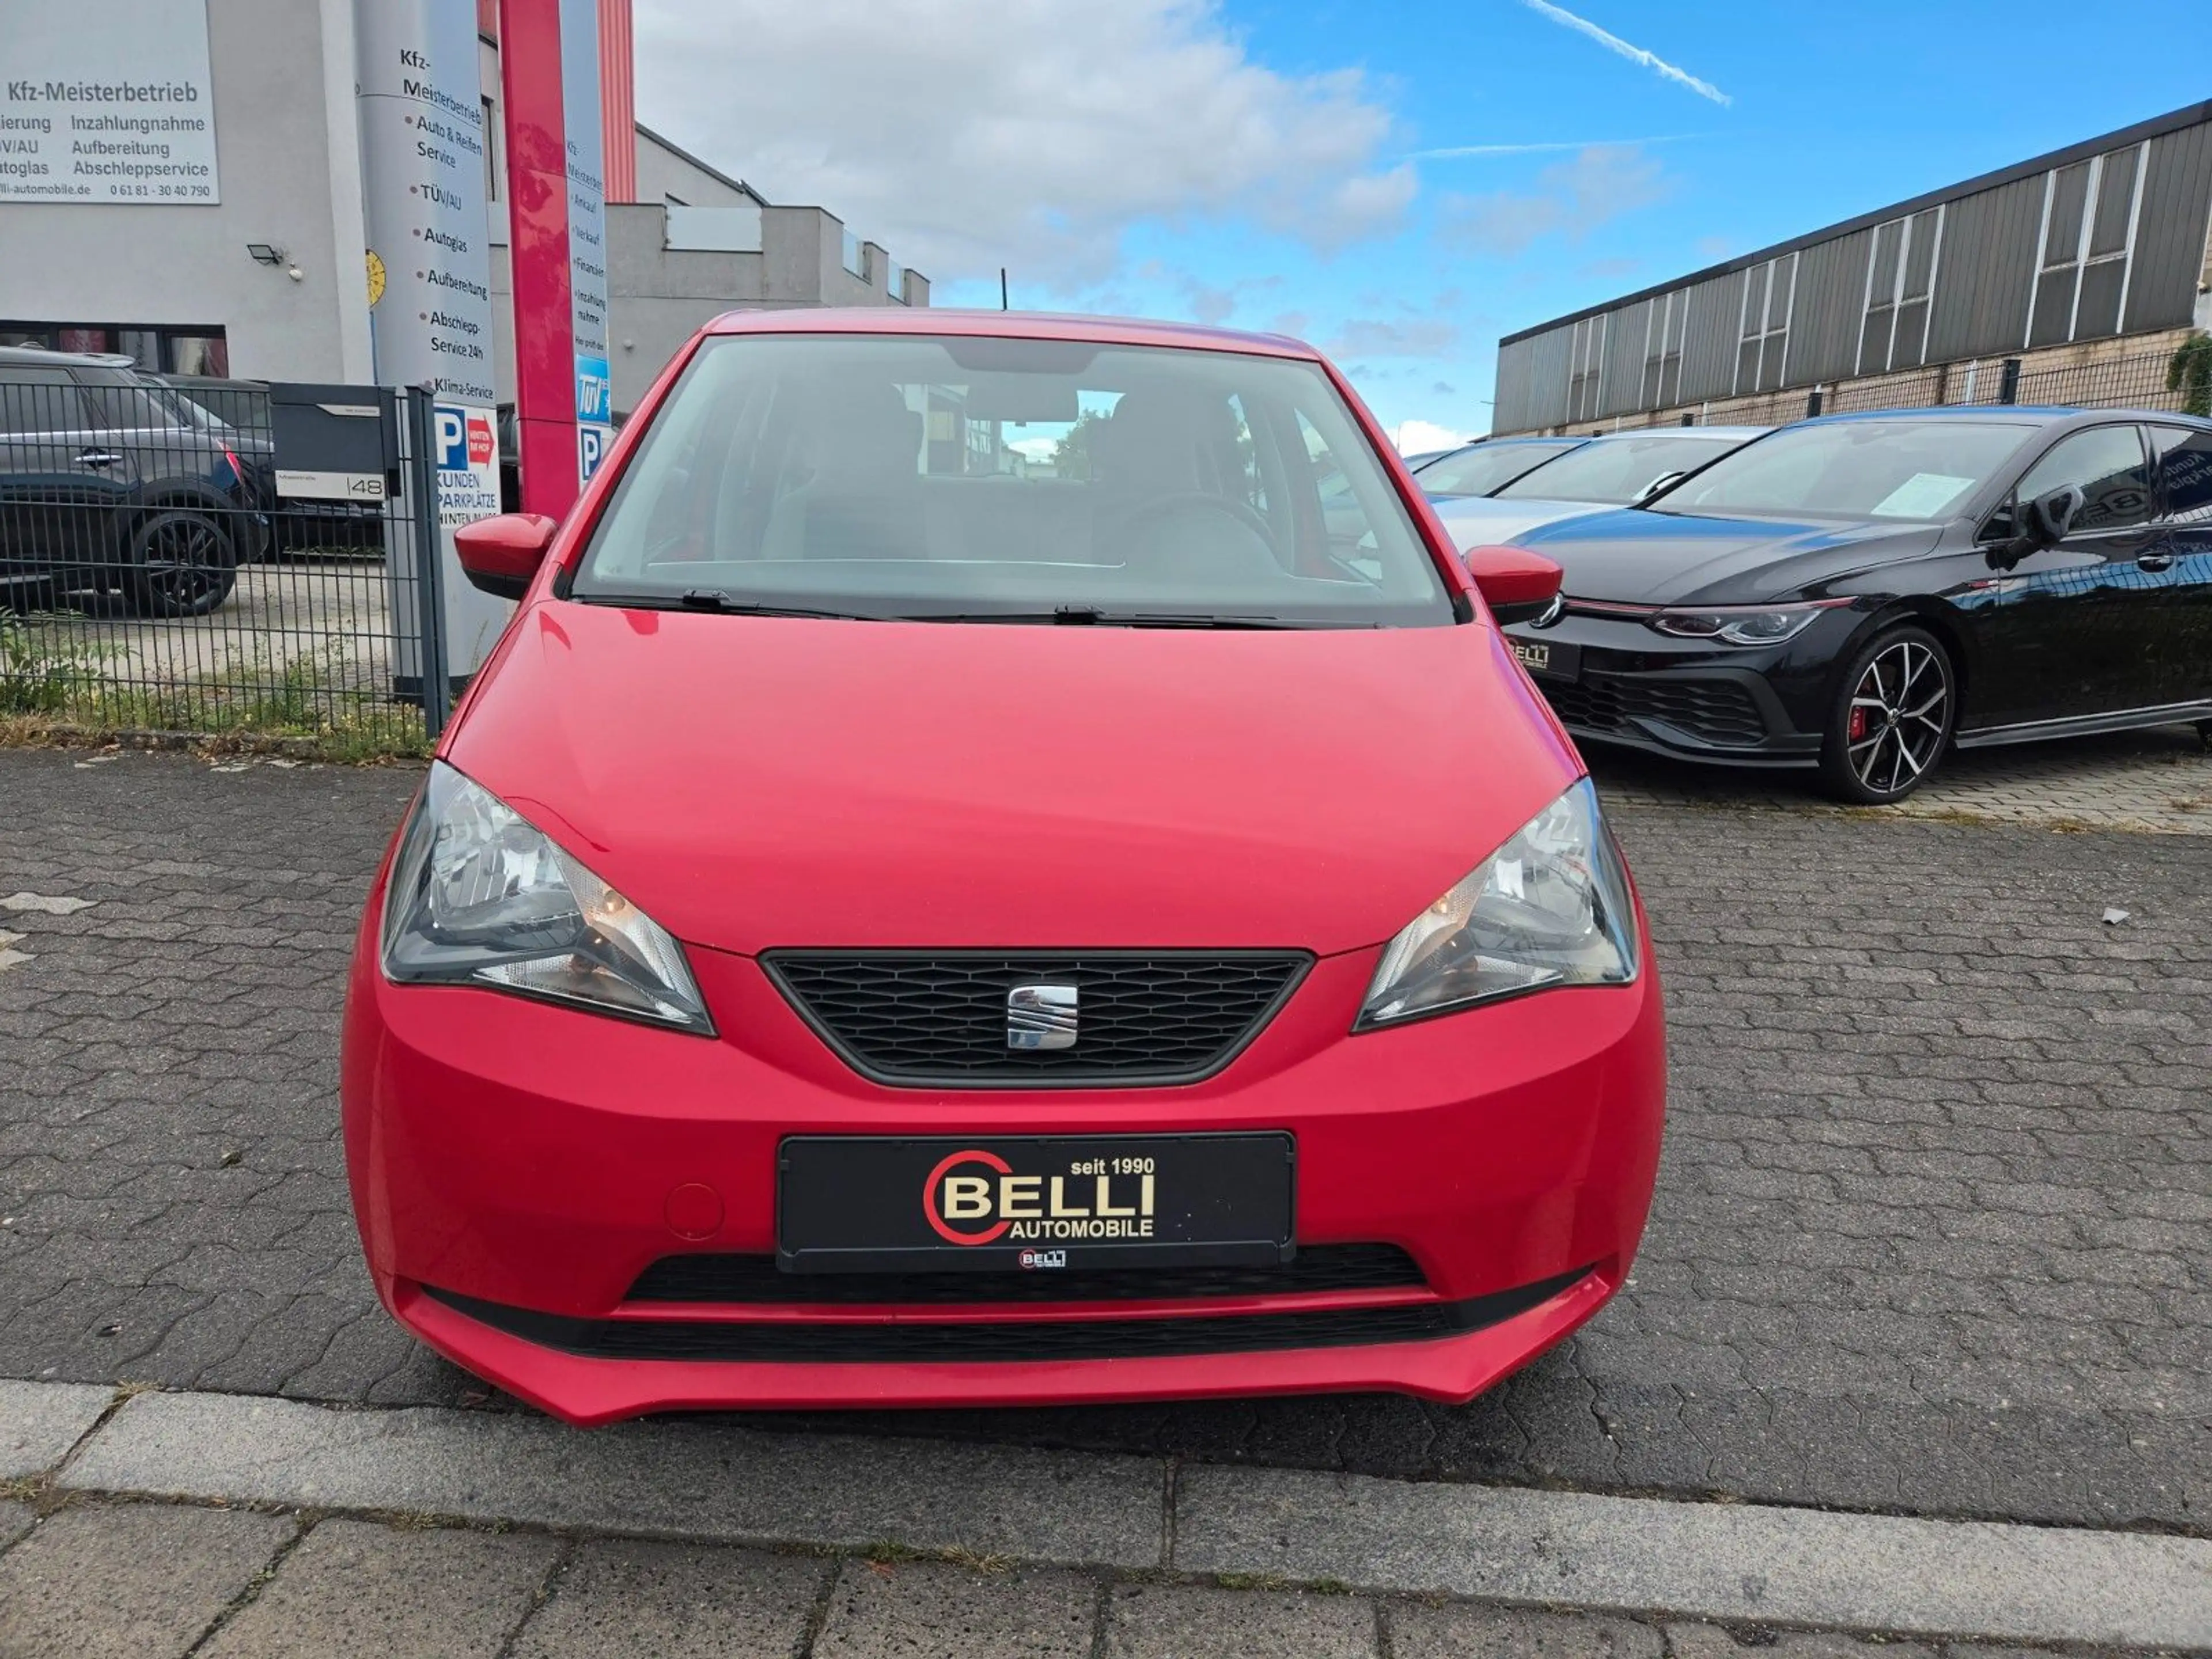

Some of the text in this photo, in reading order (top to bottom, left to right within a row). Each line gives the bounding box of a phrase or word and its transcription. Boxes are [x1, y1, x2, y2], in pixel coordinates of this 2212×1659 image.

[400, 49, 431, 70] Kfz-
[8, 81, 198, 102] Kfz-Meisterbetrieb
[403, 78, 482, 124] Meisterbetrieb
[0, 115, 51, 133] ierung
[71, 115, 205, 134] Inzahlungnahme
[0, 139, 39, 154] V/AU
[417, 116, 483, 156] Auto & Reifen
[72, 140, 170, 158] Aufbereitung
[417, 141, 456, 168] Service
[74, 160, 209, 179] Abschleppservice
[110, 185, 117, 195] 0
[120, 185, 132, 195] 61
[158, 185, 171, 196] 30
[421, 183, 461, 211] TÜV/AU
[424, 228, 467, 252] Autoglas
[427, 270, 487, 301] Aufbereitung
[431, 311, 480, 336] Abschlepp-
[431, 337, 483, 360] Service 24h
[435, 378, 494, 399] Klima-Service
[434, 412, 462, 464] P
[584, 433, 597, 476] P
[352, 479, 382, 494] 48
[1071, 1157, 1154, 1175] seit 1990
[944, 1175, 1154, 1219] BELLI
[1009, 1219, 1154, 1238] AUTOMOBILE
